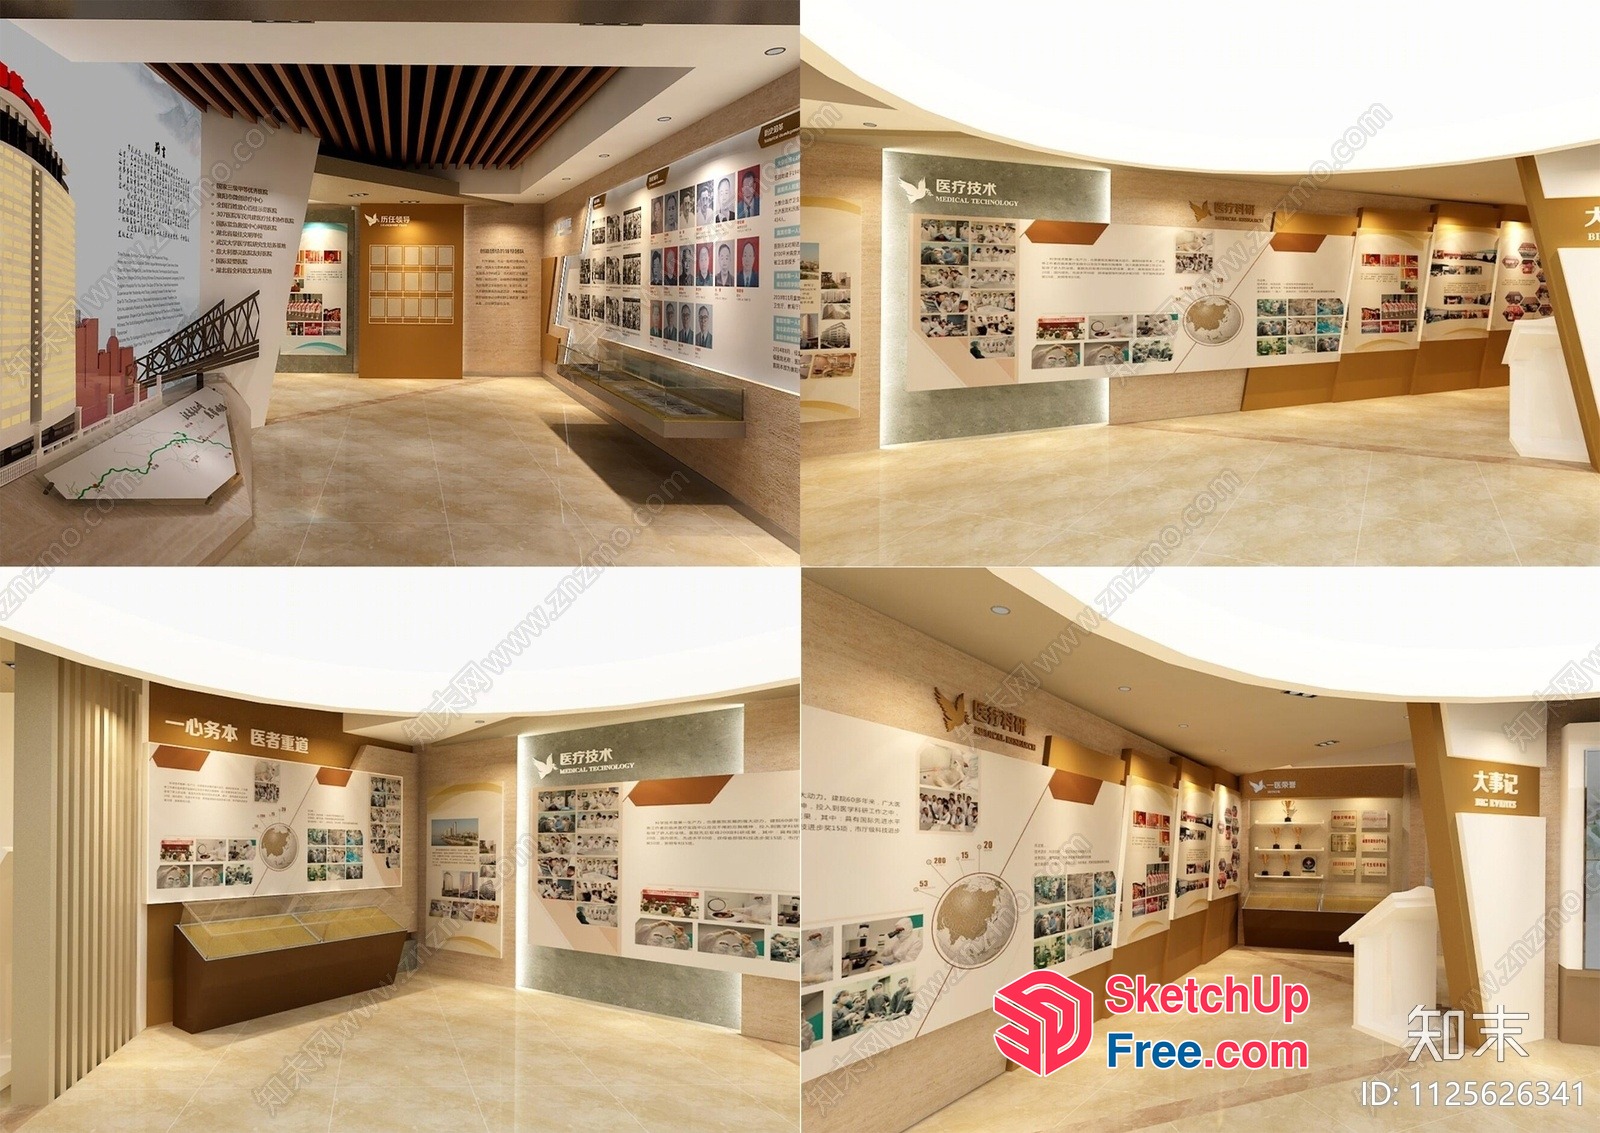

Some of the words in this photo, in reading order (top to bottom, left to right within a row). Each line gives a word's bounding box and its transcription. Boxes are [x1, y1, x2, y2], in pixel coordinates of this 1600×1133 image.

[936, 178, 997, 196] 医疗技术
[935, 195, 970, 204] MEDICAL
[970, 197, 1019, 206] TECHNOLOGY
[1213, 201, 1256, 216] 医疗科研
[380, 215, 411, 224] 历任领导
[972, 699, 1027, 737] 医疗科研
[165, 717, 238, 743] 一心务本
[250, 728, 309, 754] 医者重道
[973, 726, 1005, 742] MEDICAL
[1005, 735, 1036, 751] RESEARCH
[559, 747, 613, 766] 医疗技术
[559, 766, 588, 775] MEDICAL
[588, 762, 635, 772] TECHNOLOGY
[1472, 769, 1519, 795] 大事记
[983, 840, 993, 850] 20
[961, 851, 969, 859] 15
[919, 879, 928, 888] 53
